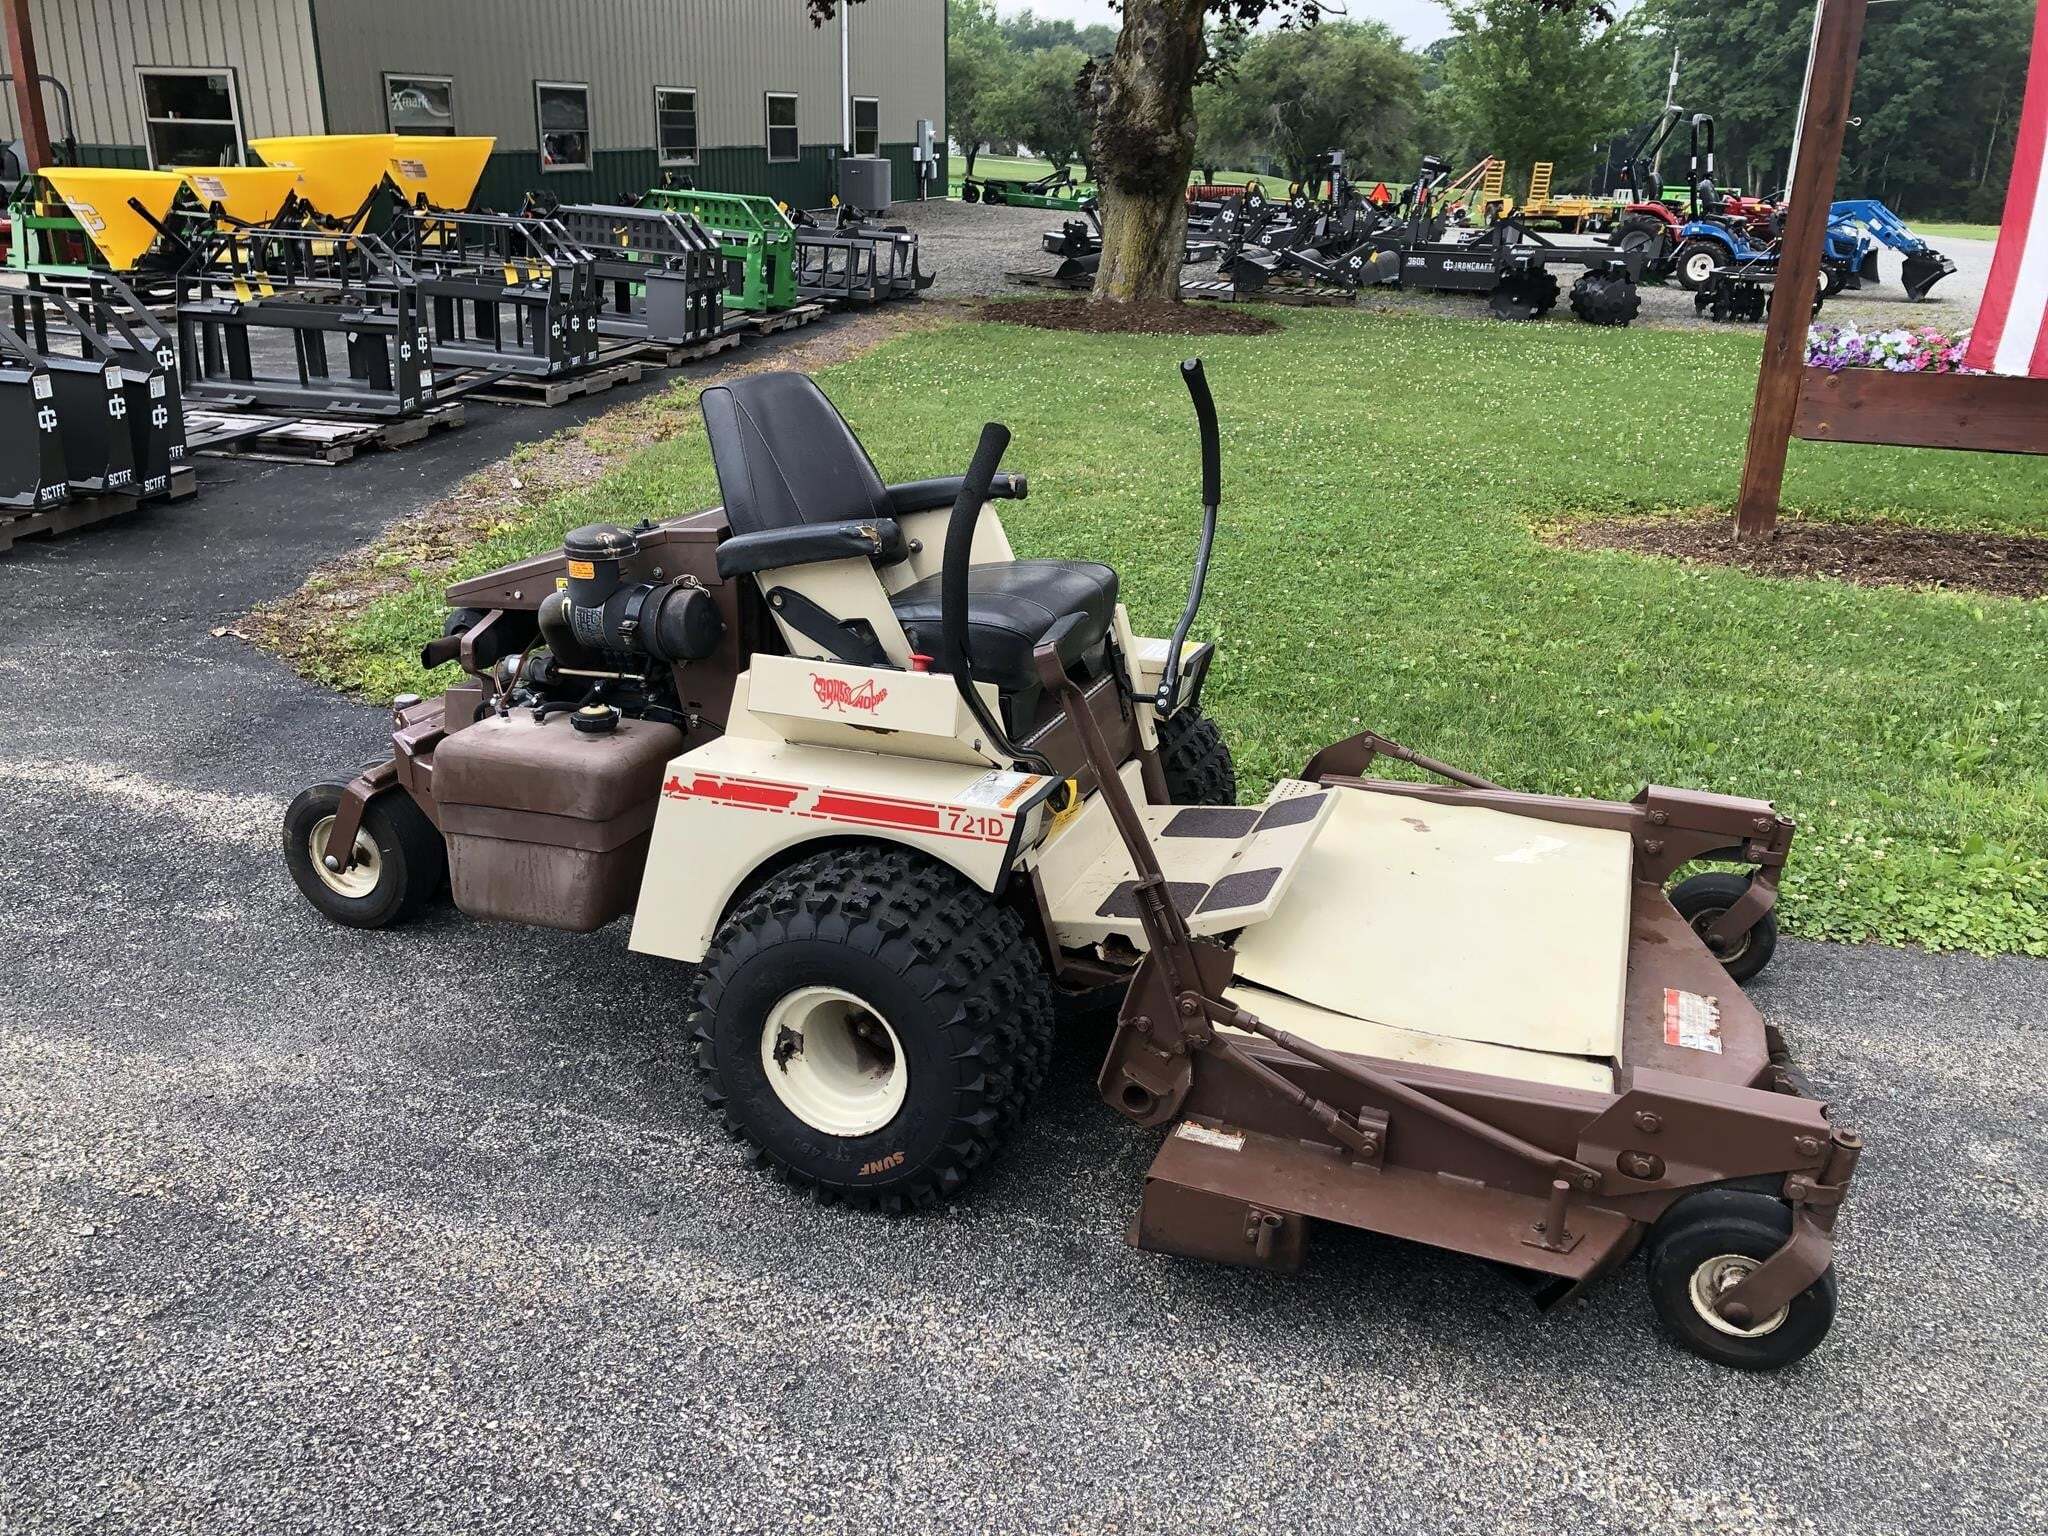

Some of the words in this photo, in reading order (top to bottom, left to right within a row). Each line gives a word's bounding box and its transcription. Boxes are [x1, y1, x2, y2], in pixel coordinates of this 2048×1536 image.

[1454, 261, 1493, 271] IRONCRAFT
[108, 469, 132, 486] SCTFF
[144, 475, 167, 491] SCTFF
[40, 482, 66, 501] SCTFF
[948, 813, 1003, 836] 721D
[857, 1151, 905, 1176] SUNF
